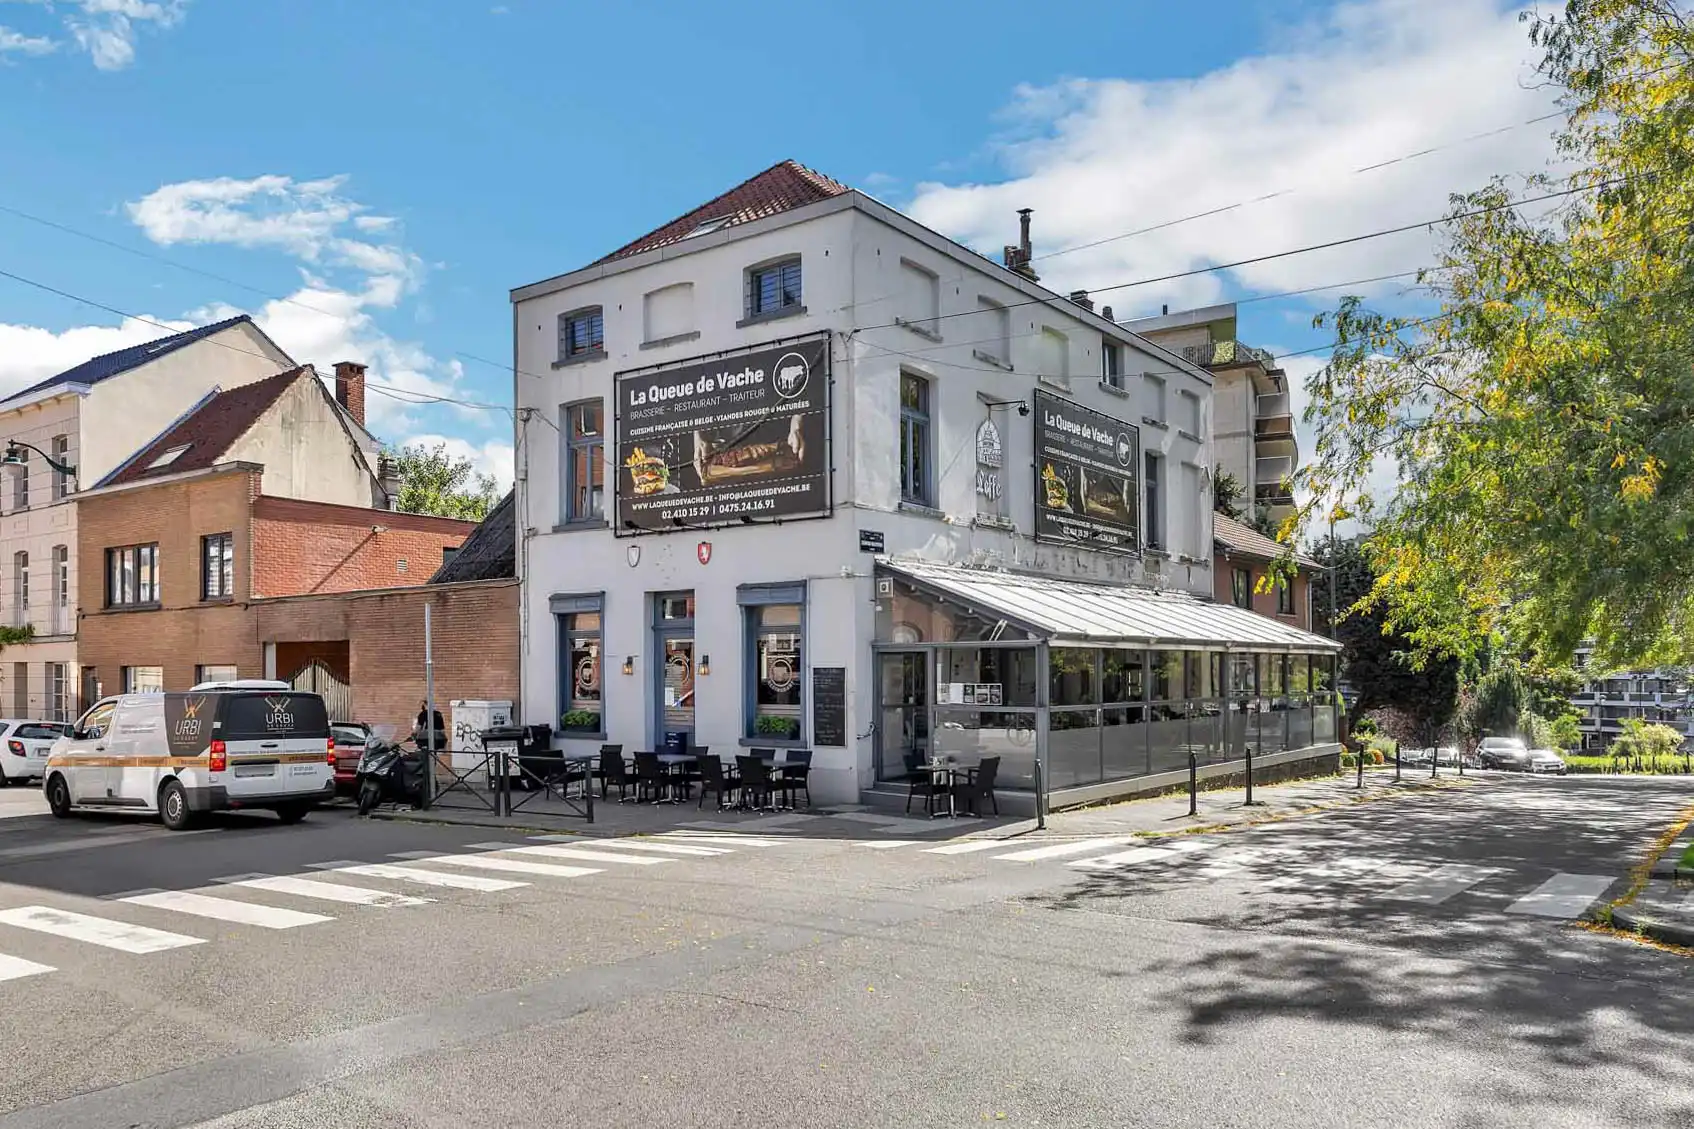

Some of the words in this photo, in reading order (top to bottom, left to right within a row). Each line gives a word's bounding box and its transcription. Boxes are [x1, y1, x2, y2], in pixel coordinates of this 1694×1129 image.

[630, 390, 646, 406] La
[648, 385, 694, 403] Queue
[696, 375, 714, 394] de
[716, 367, 765, 389] Vache
[630, 405, 665, 420] BRASSERIE
[674, 395, 721, 412] RESTAURANT
[729, 388, 765, 403] TRAITEUR
[655, 419, 688, 432] FRANÇAISE
[716, 411, 744, 422] VIANDES
[1045, 409, 1055, 427] La
[1056, 414, 1081, 436] Queue
[1081, 423, 1092, 439] de
[1091, 425, 1114, 447] Vache
[718, 483, 811, 502] INFO@LAQUEUEDEVACHE.BE
[976, 469, 1001, 501] Leffe
[662, 507, 688, 519] 02.410
[689, 507, 698, 517] 15
[699, 506, 710, 516] 29
[719, 499, 776, 514] 0475.24.16.91
[175, 719, 202, 735] URBI
[265, 713, 294, 724] URBI
